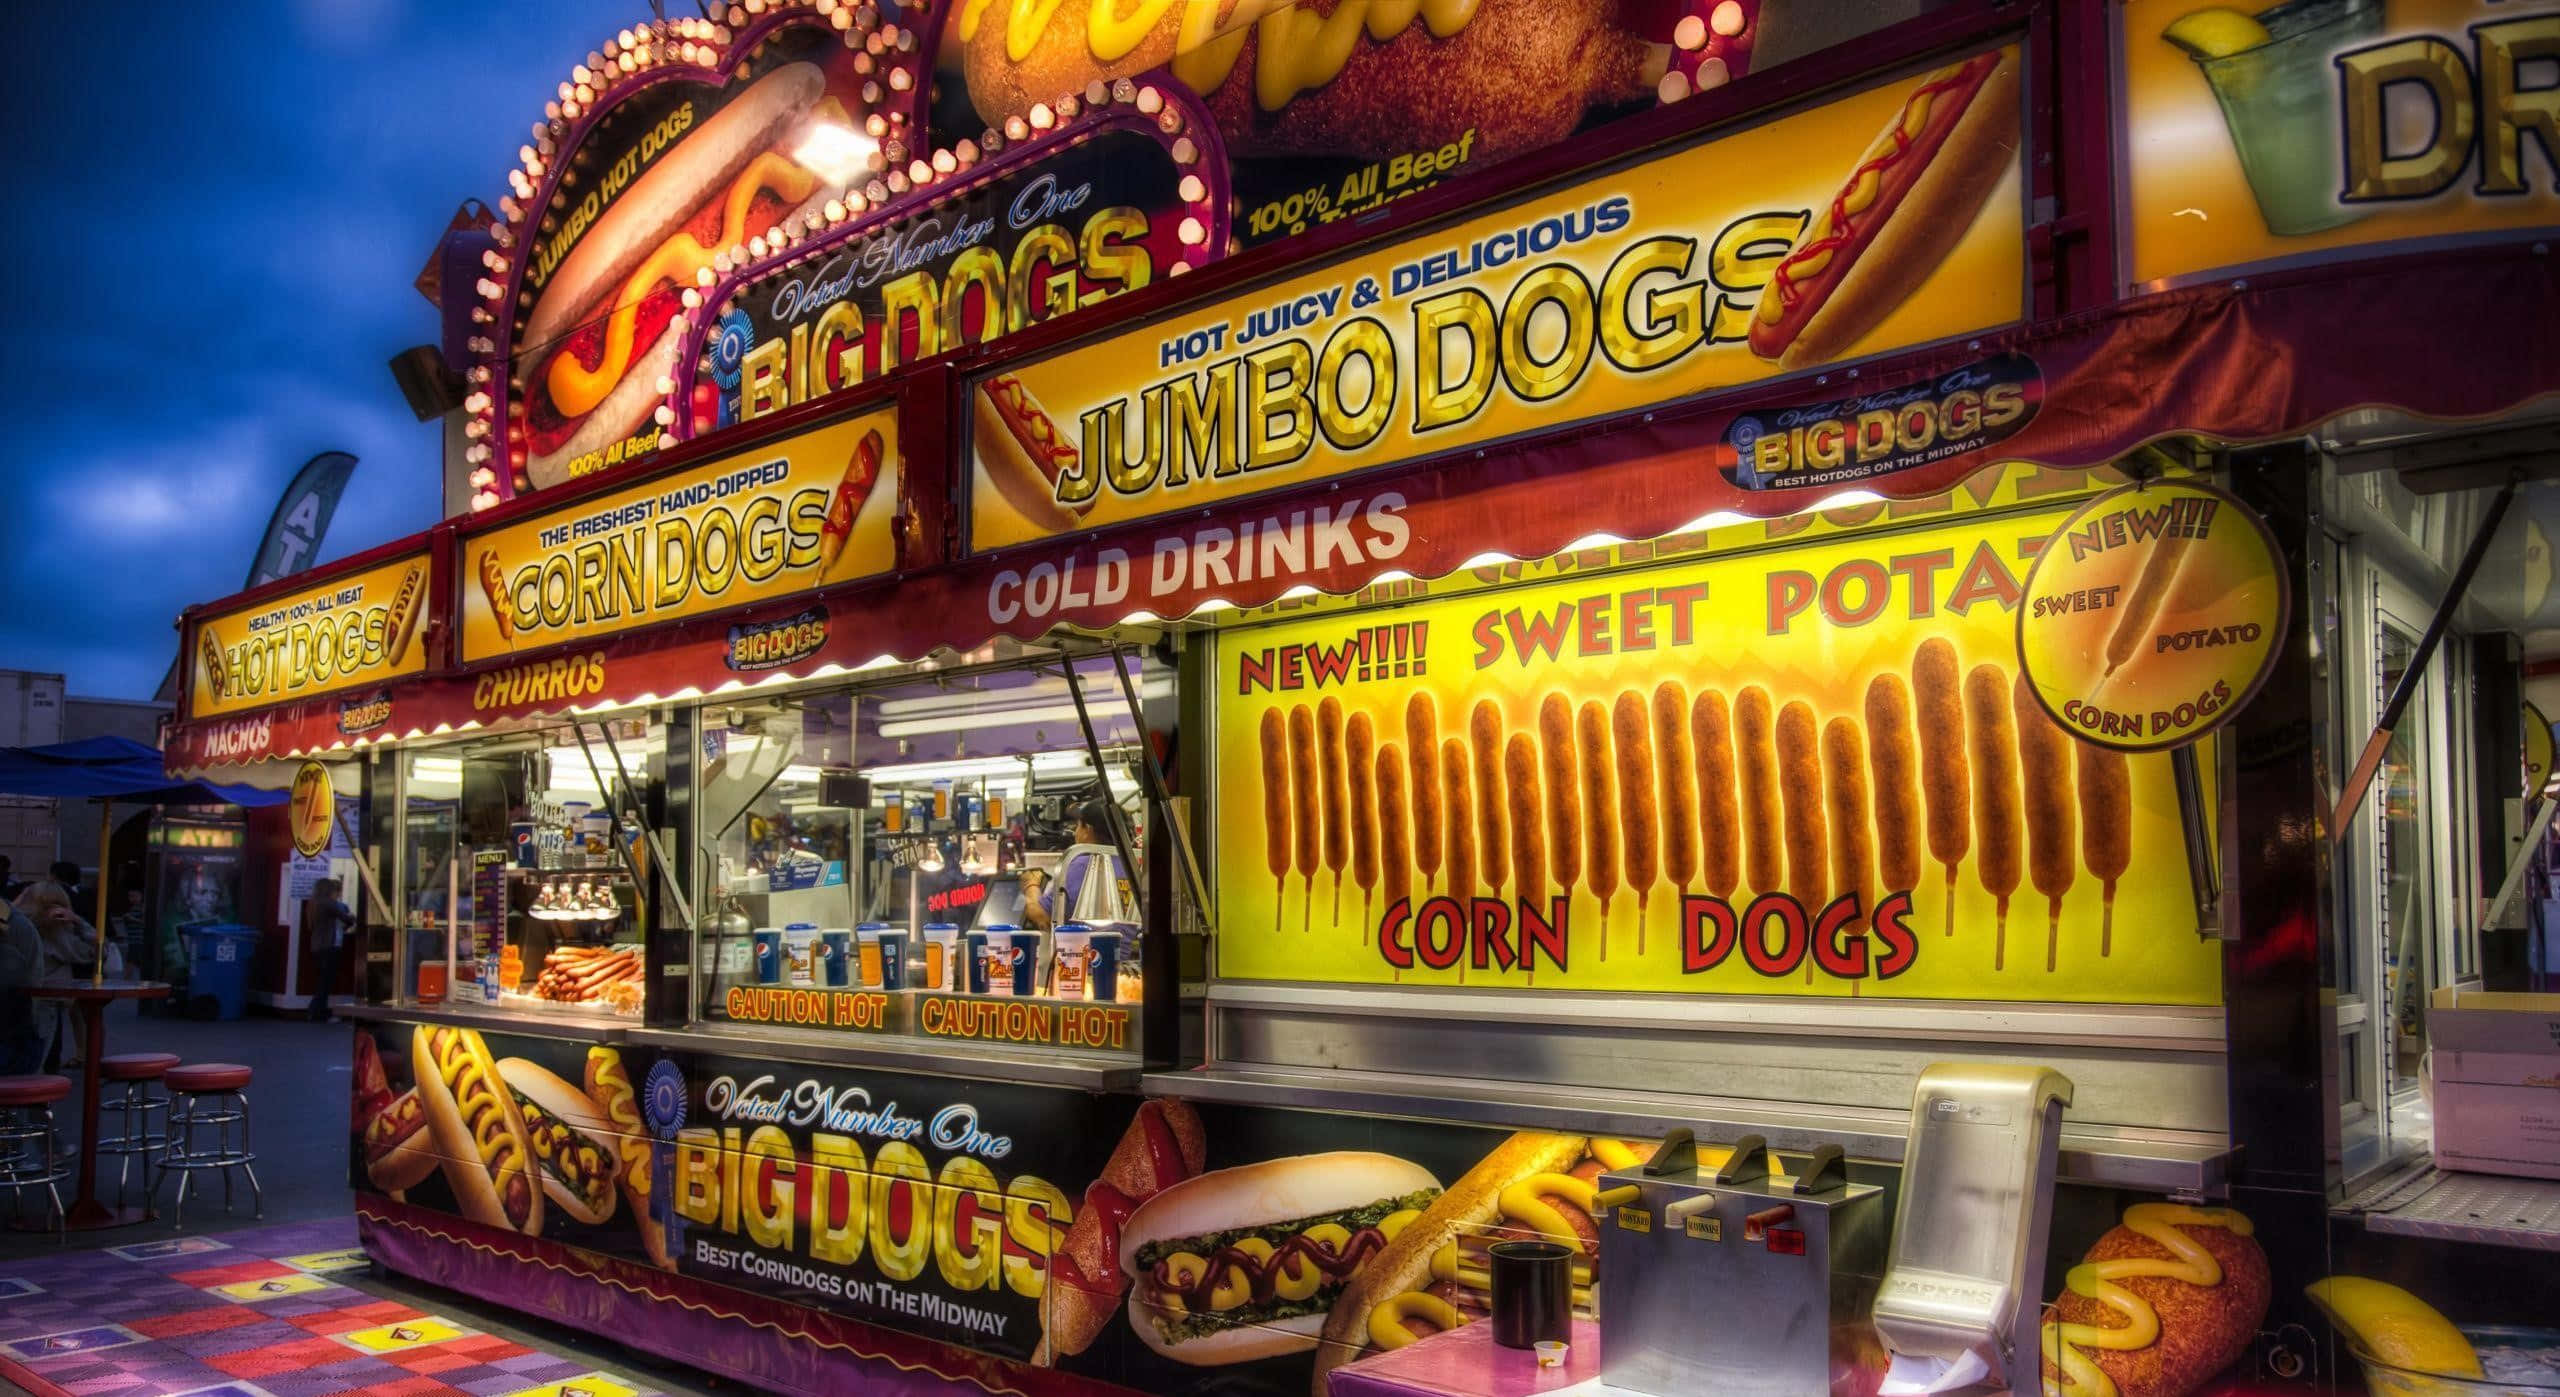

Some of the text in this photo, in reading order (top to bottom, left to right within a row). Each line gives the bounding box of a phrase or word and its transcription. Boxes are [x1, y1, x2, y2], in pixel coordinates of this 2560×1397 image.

[532, 102, 693, 288] JUMBO HOT DOGS
[1249, 183, 1330, 237] 100%
[1339, 164, 1379, 205] All
[1387, 128, 1476, 191] Beef
[772, 174, 1091, 324] Voted Number One
[1160, 323, 1230, 368] HOT
[1236, 286, 1342, 344] JUICY
[1352, 278, 1381, 309] &
[1391, 198, 1630, 297] DELICIOUS
[742, 310, 866, 427] BIG
[878, 206, 1153, 362] DOGS
[1056, 208, 1811, 503] JUMBO DOGS
[568, 428, 661, 478] 100% All Beef
[1755, 383, 2024, 474] BIG DOGS
[1775, 436, 1985, 487] BEST HOTDOGS ON THE MIDWAY
[260, 491, 320, 585] AT
[540, 459, 788, 548] THE FRESHEST HAND-DIPPED
[2068, 499, 2219, 562] NEW!!!
[510, 488, 830, 630] CORN DOGS
[987, 535, 1130, 625] COLD
[1150, 491, 1411, 598] DRINKS
[2033, 585, 2120, 618] SWEET
[225, 607, 390, 699] HOT DOGS
[248, 585, 363, 632] HEALTHY 100% ALL MEAT
[735, 633, 767, 661] BIG
[769, 621, 825, 659] DOGS
[1239, 620, 1429, 695] NEW!!!!
[1472, 582, 1709, 671] SWEET
[2157, 623, 2261, 653] POTATO
[474, 651, 605, 710] CHURROS
[2064, 679, 2231, 738] CORN DOGS
[203, 718, 272, 758] NACHOS
[478, 854, 502, 864] MENU
[1378, 890, 1920, 982] CORN DOGS
[727, 988, 887, 1029] CAUTION HOT
[922, 998, 1128, 1049] CAUTION HOT
[706, 1074, 1012, 1158] Voted Number One
[674, 1125, 1075, 1299] BIG DOGS
[695, 1239, 1008, 1337] BEST CORNDOGS ON THE MIDWAY
